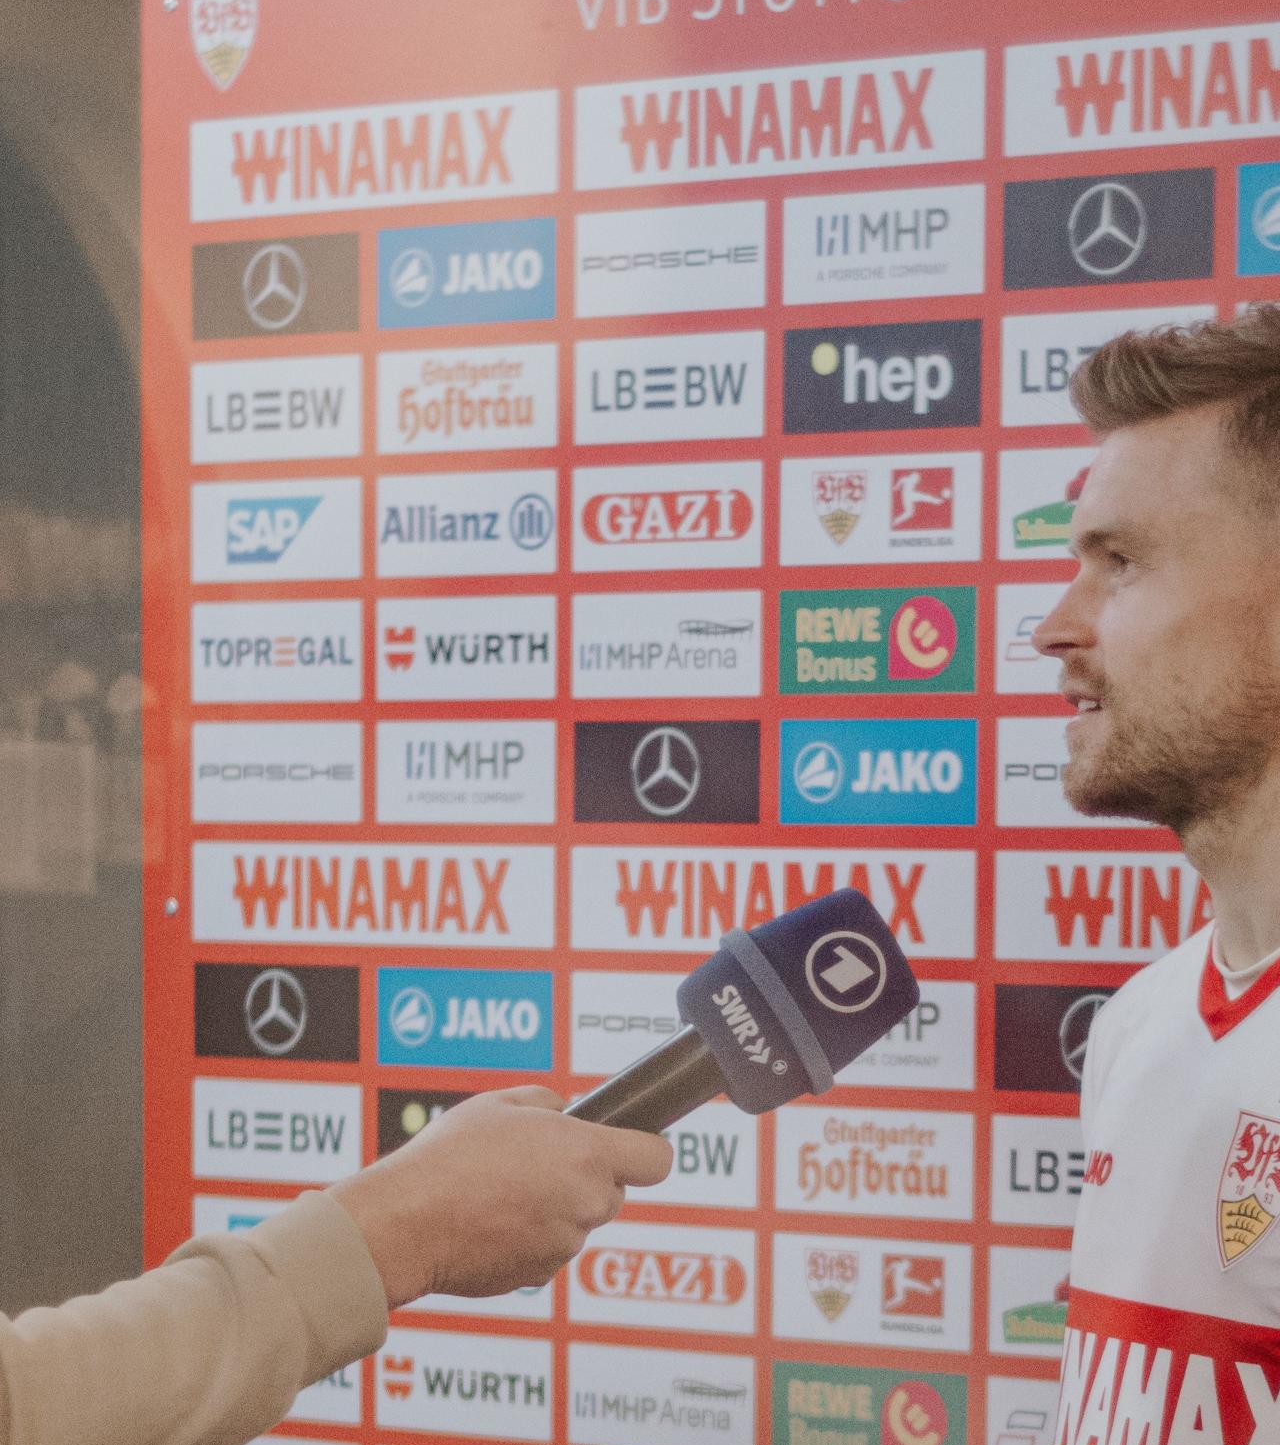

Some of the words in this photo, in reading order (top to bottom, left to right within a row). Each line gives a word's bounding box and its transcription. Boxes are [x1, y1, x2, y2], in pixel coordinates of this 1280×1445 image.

[620, 67, 934, 174] WINAMAX
[231, 106, 515, 205] WINAMAX
[859, 208, 950, 253] MHP
[442, 248, 543, 296] JAKO
[581, 245, 759, 274] PORSCHE
[844, 345, 952, 413] hep
[398, 381, 534, 444] Hofbräu
[227, 510, 301, 552] SAP
[381, 506, 499, 544] Allianz
[596, 491, 739, 543] GAZI
[796, 607, 880, 643] REWE
[797, 648, 876, 683] Bonus
[197, 764, 354, 781] PORSCHE
[444, 741, 524, 780] MHP
[851, 750, 963, 793] JAKO
[234, 855, 510, 935] WINAMAX
[616, 859, 926, 945] WINAMX
[441, 997, 538, 1040] JAKO
[578, 1014, 677, 1034] PORS
[712, 985, 760, 1047] SWR
[798, 1141, 948, 1200] Hofbräu
[591, 1251, 734, 1302] GAZI
[788, 1381, 874, 1421] REWE
